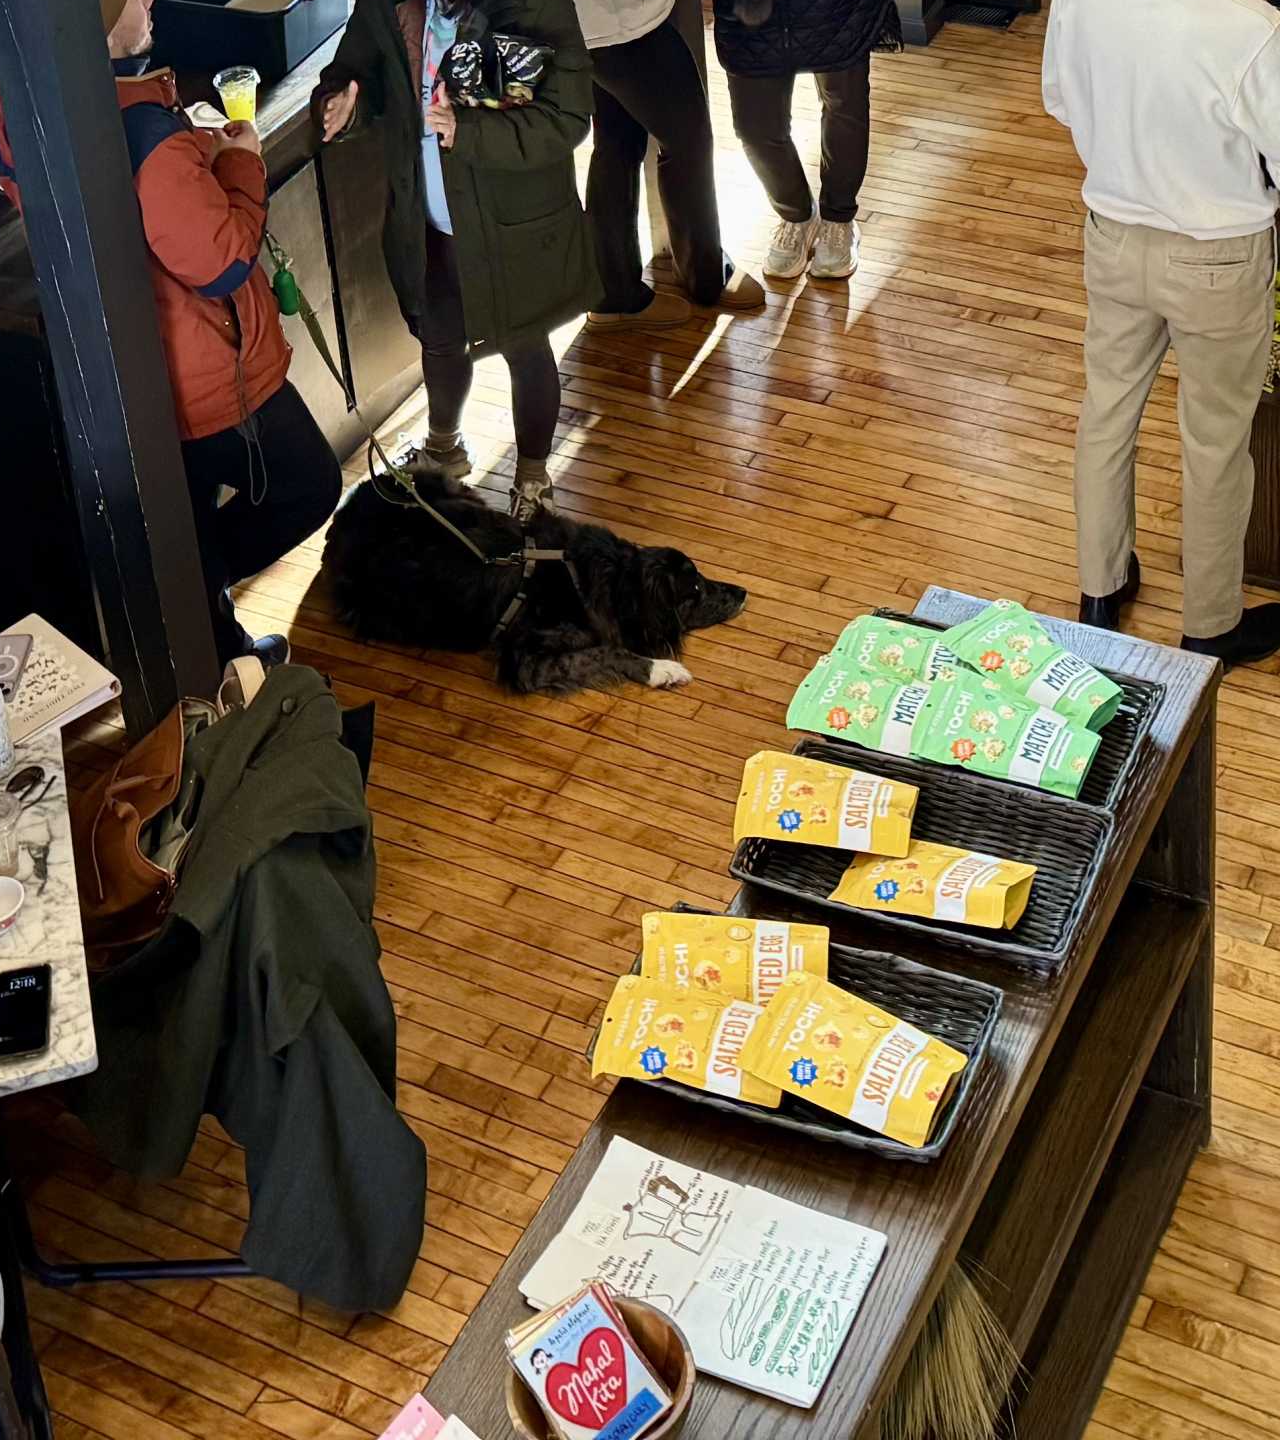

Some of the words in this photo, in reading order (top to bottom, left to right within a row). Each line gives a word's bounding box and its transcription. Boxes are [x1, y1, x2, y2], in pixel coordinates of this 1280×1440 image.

[857, 632, 879, 663] OCHI
[1042, 653, 1089, 692] MATCHA
[944, 690, 974, 736] TOCHI
[1019, 717, 1058, 764] MATCHA
[767, 768, 789, 813] TOCHI
[759, 934, 785, 954] EGG
[758, 962, 784, 1008] ALTED
[629, 998, 658, 1051] TOCHI
[784, 1001, 824, 1053] TOCHI
[713, 1020, 749, 1078] SALTED
[862, 1047, 906, 1107] SALTED
[558, 1338, 616, 1417] Mahal
[588, 1374, 623, 1425] Kita
